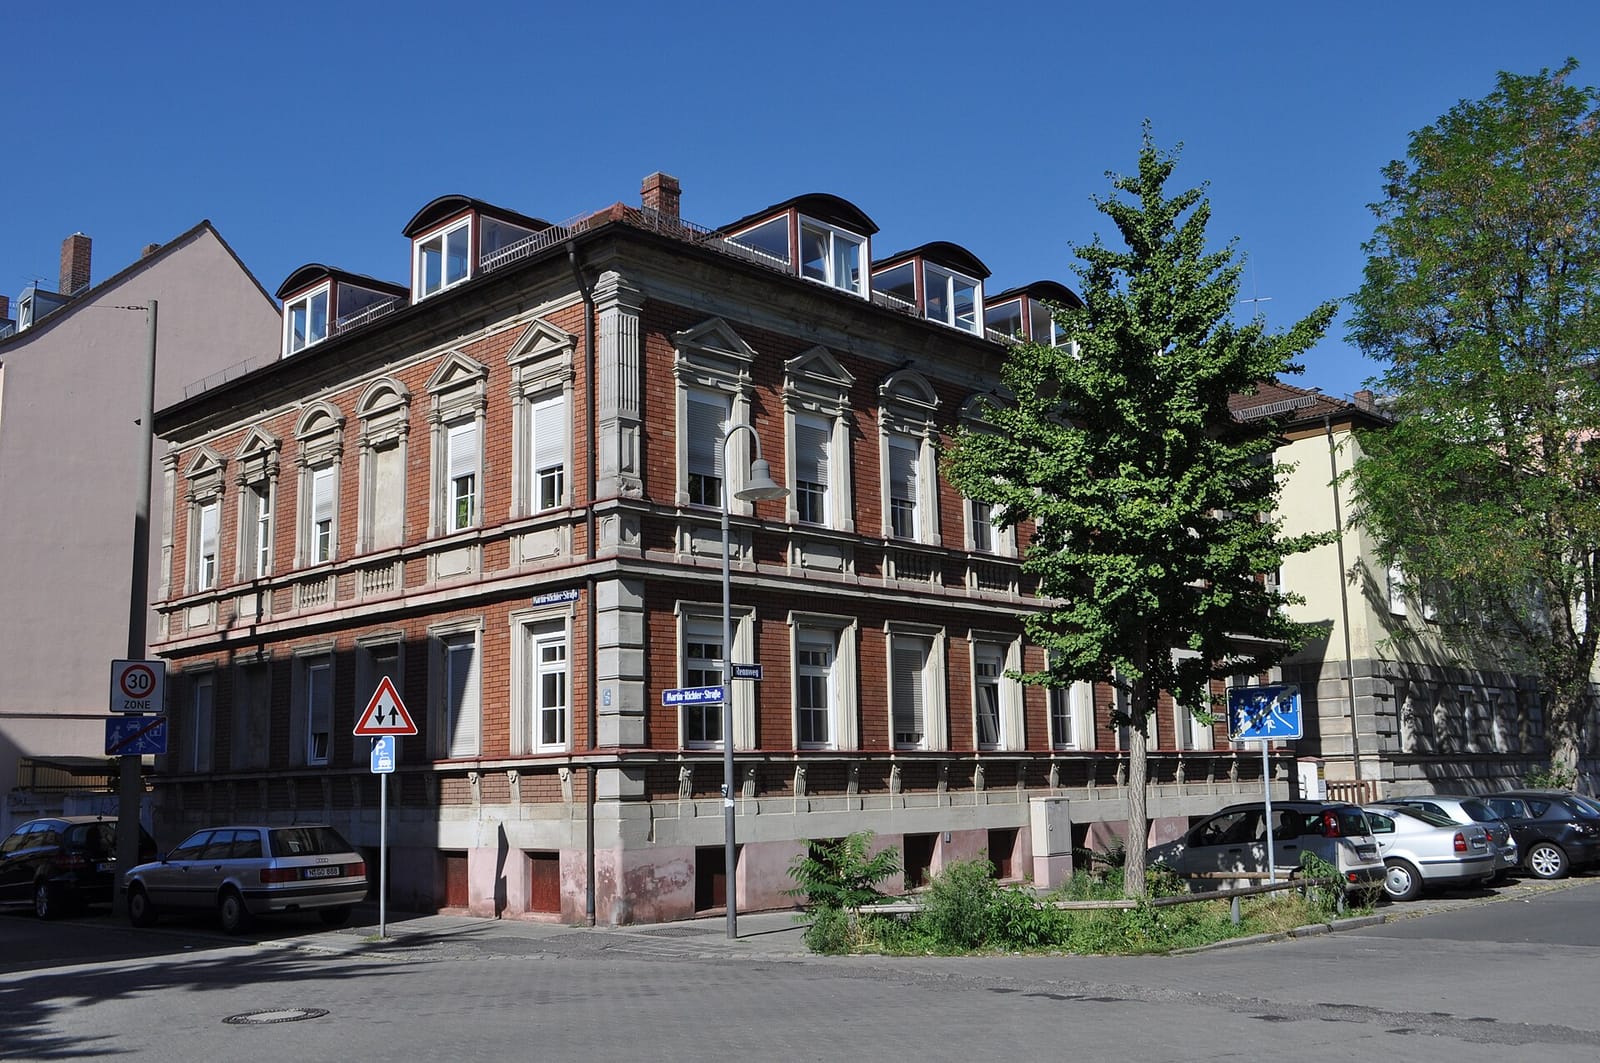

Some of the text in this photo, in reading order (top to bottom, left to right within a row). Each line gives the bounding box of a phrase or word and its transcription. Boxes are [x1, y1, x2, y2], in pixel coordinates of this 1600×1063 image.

[127, 673, 149, 690] 30
[666, 689, 721, 702] Martin-Richter-Straße
[124, 700, 151, 710] ZONE
[375, 738, 386, 756] P
